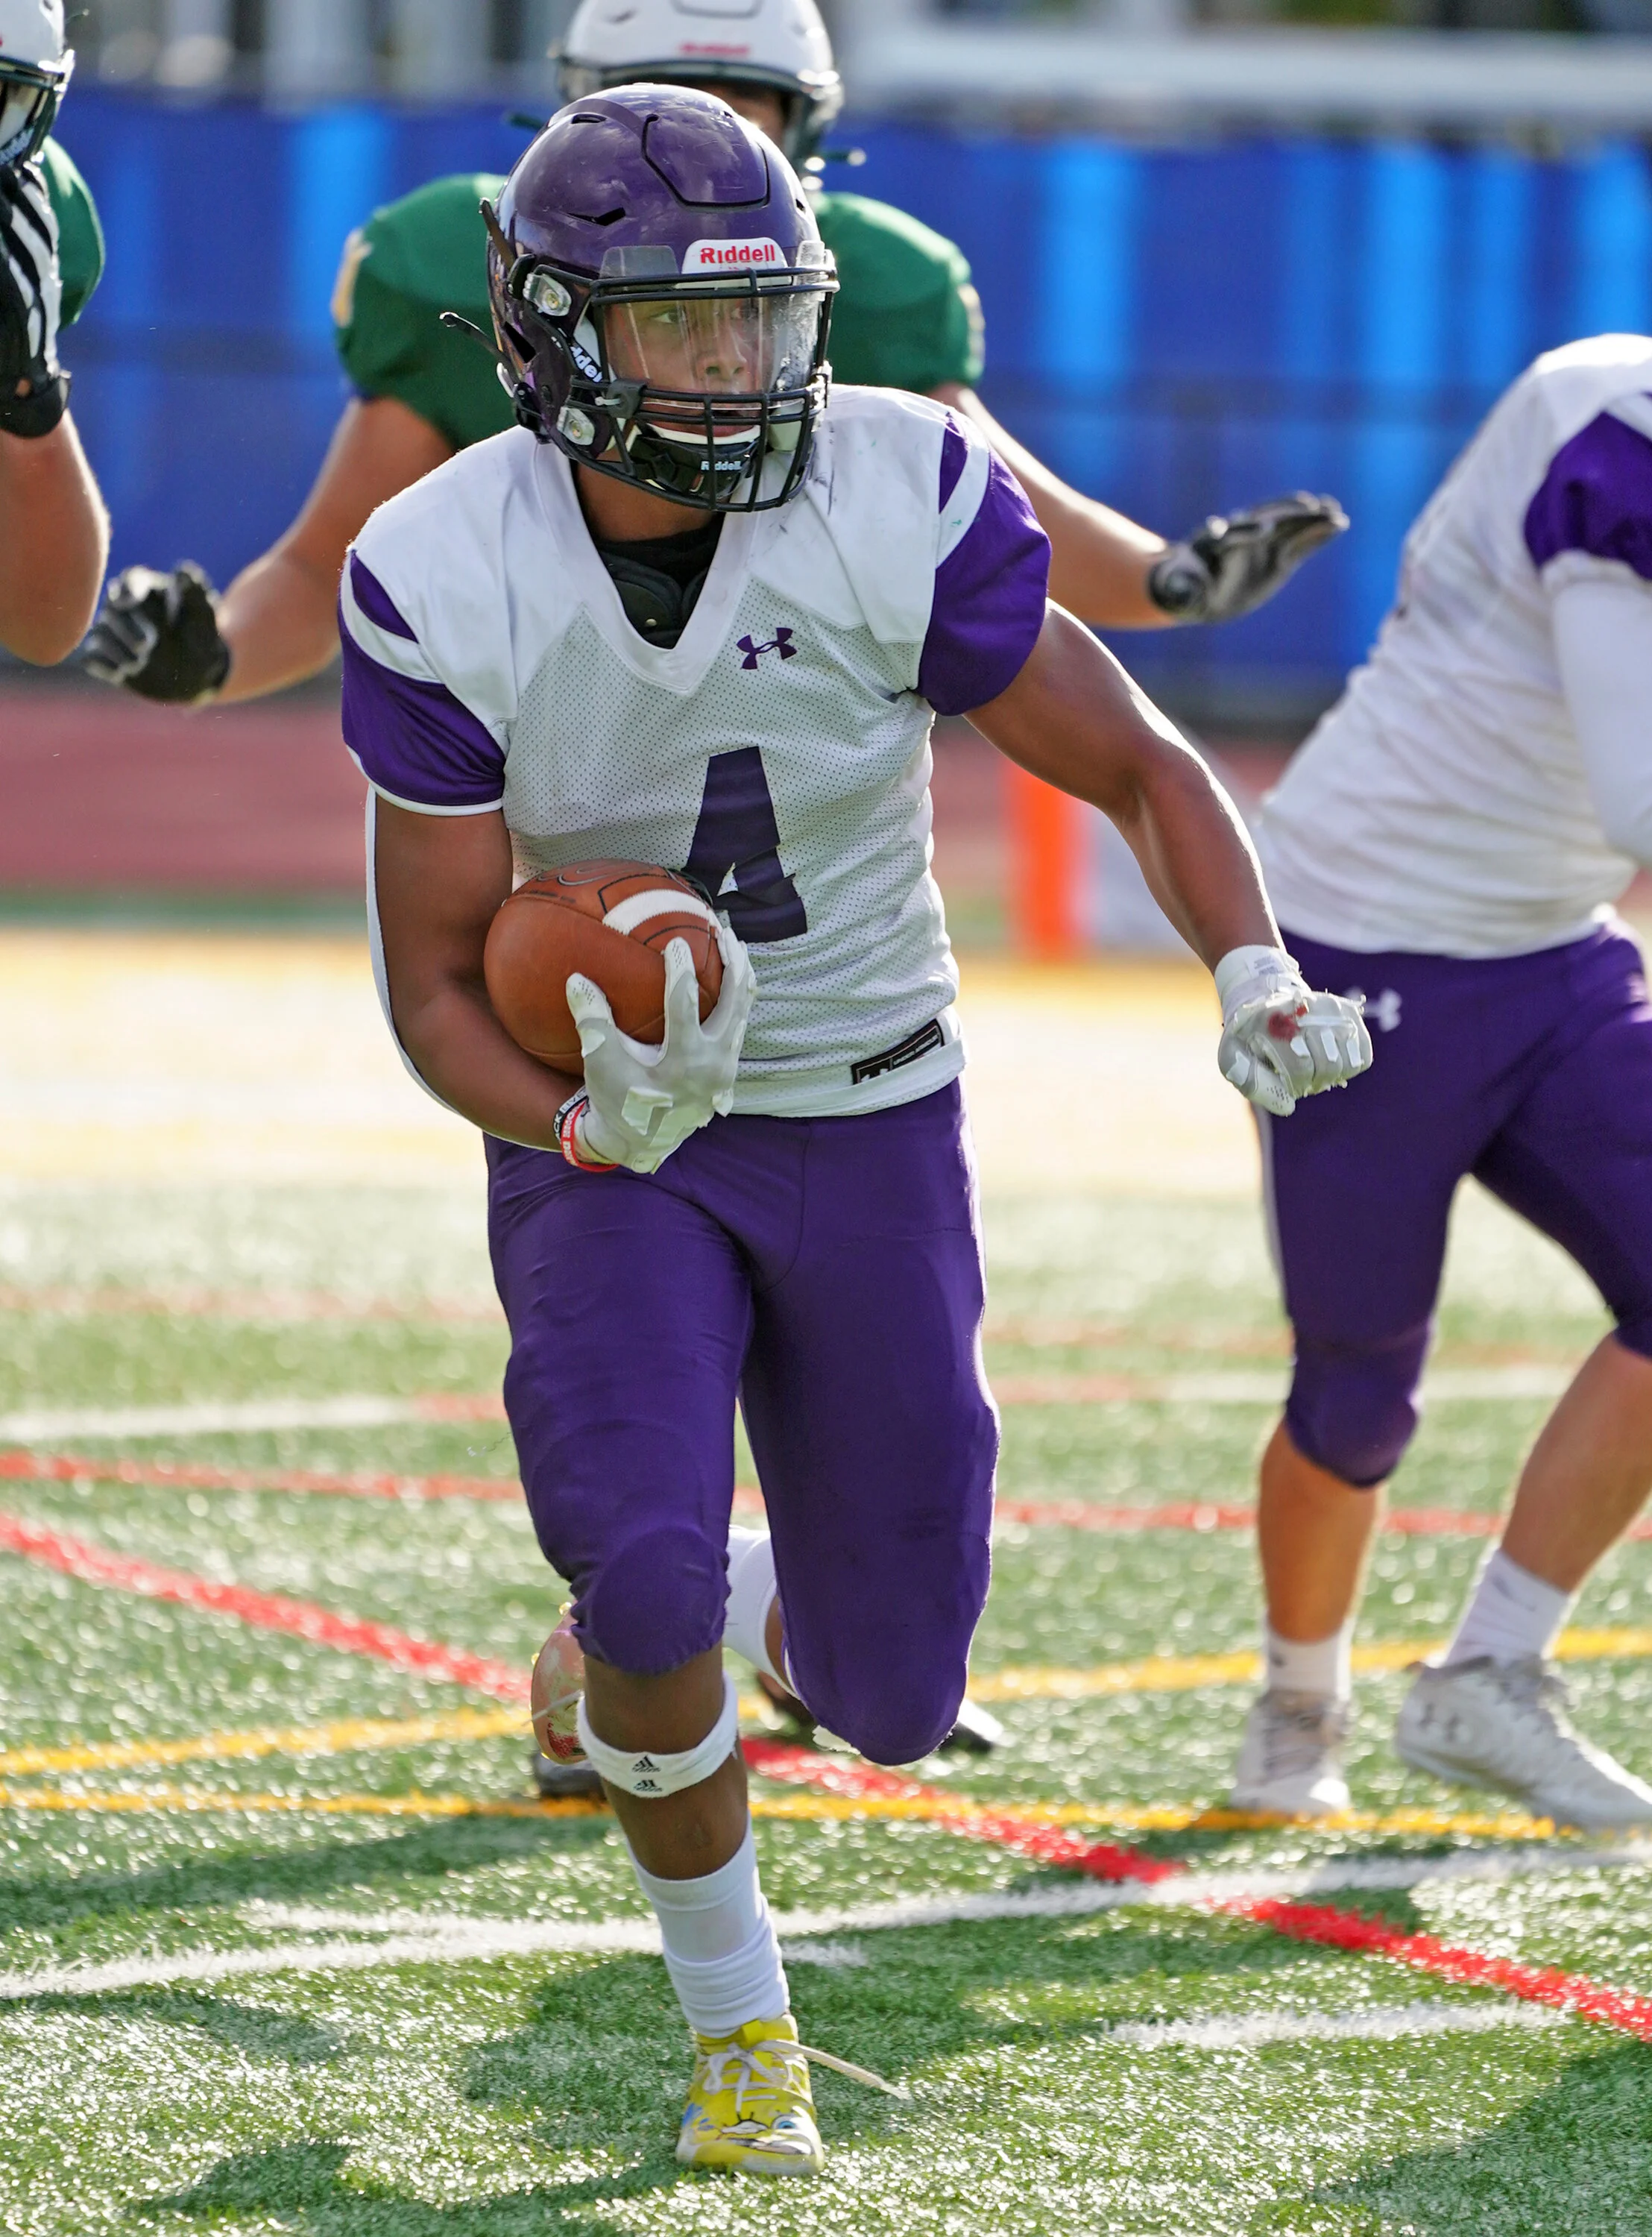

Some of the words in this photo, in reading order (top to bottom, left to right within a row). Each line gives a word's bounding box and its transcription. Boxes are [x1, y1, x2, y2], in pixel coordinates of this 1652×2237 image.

[700, 244, 775, 264] Riddell
[701, 460, 742, 471] Rddell
[680, 746, 808, 944] 4
